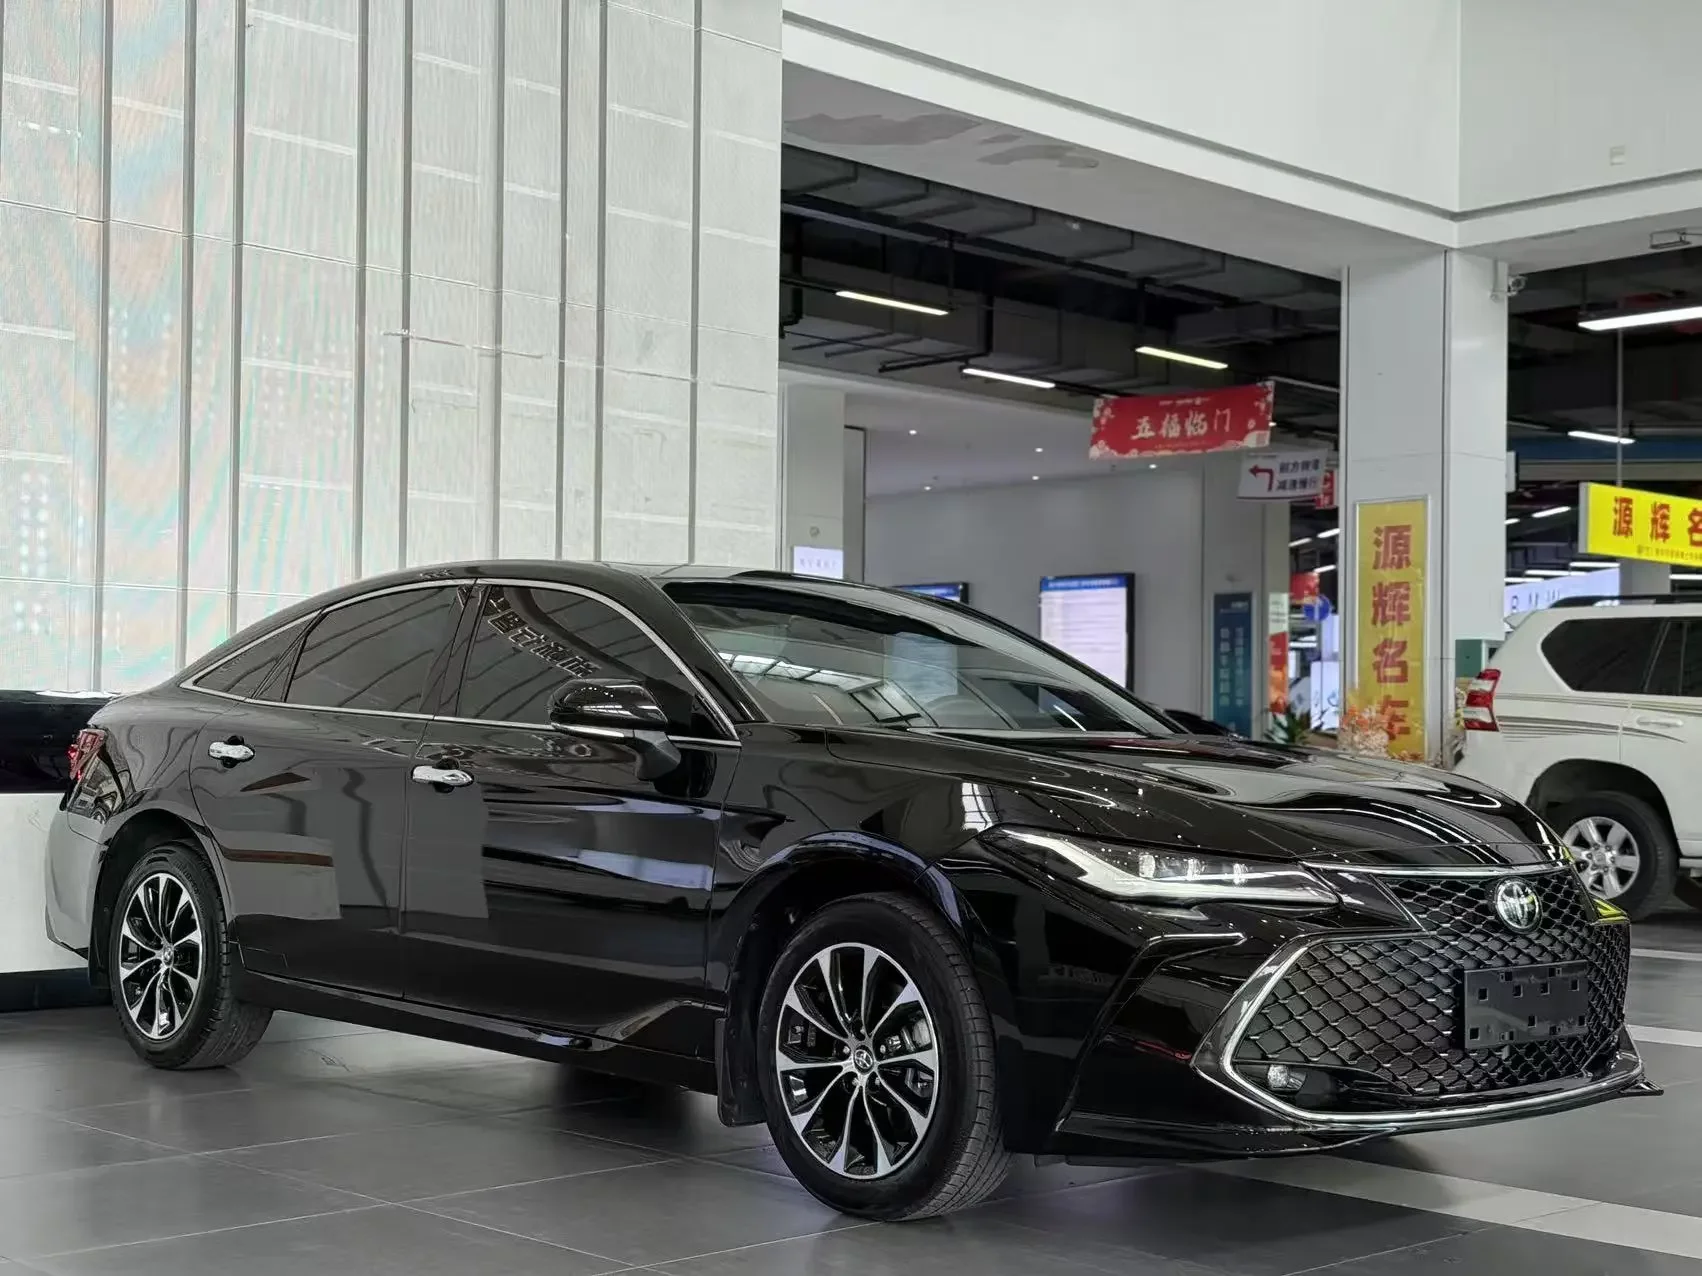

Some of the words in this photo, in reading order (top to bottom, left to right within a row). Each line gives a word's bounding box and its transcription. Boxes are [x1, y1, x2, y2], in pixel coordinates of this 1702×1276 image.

[1130, 408, 1232, 440] 五福临门
[1612, 495, 1702, 548] 源辉名
